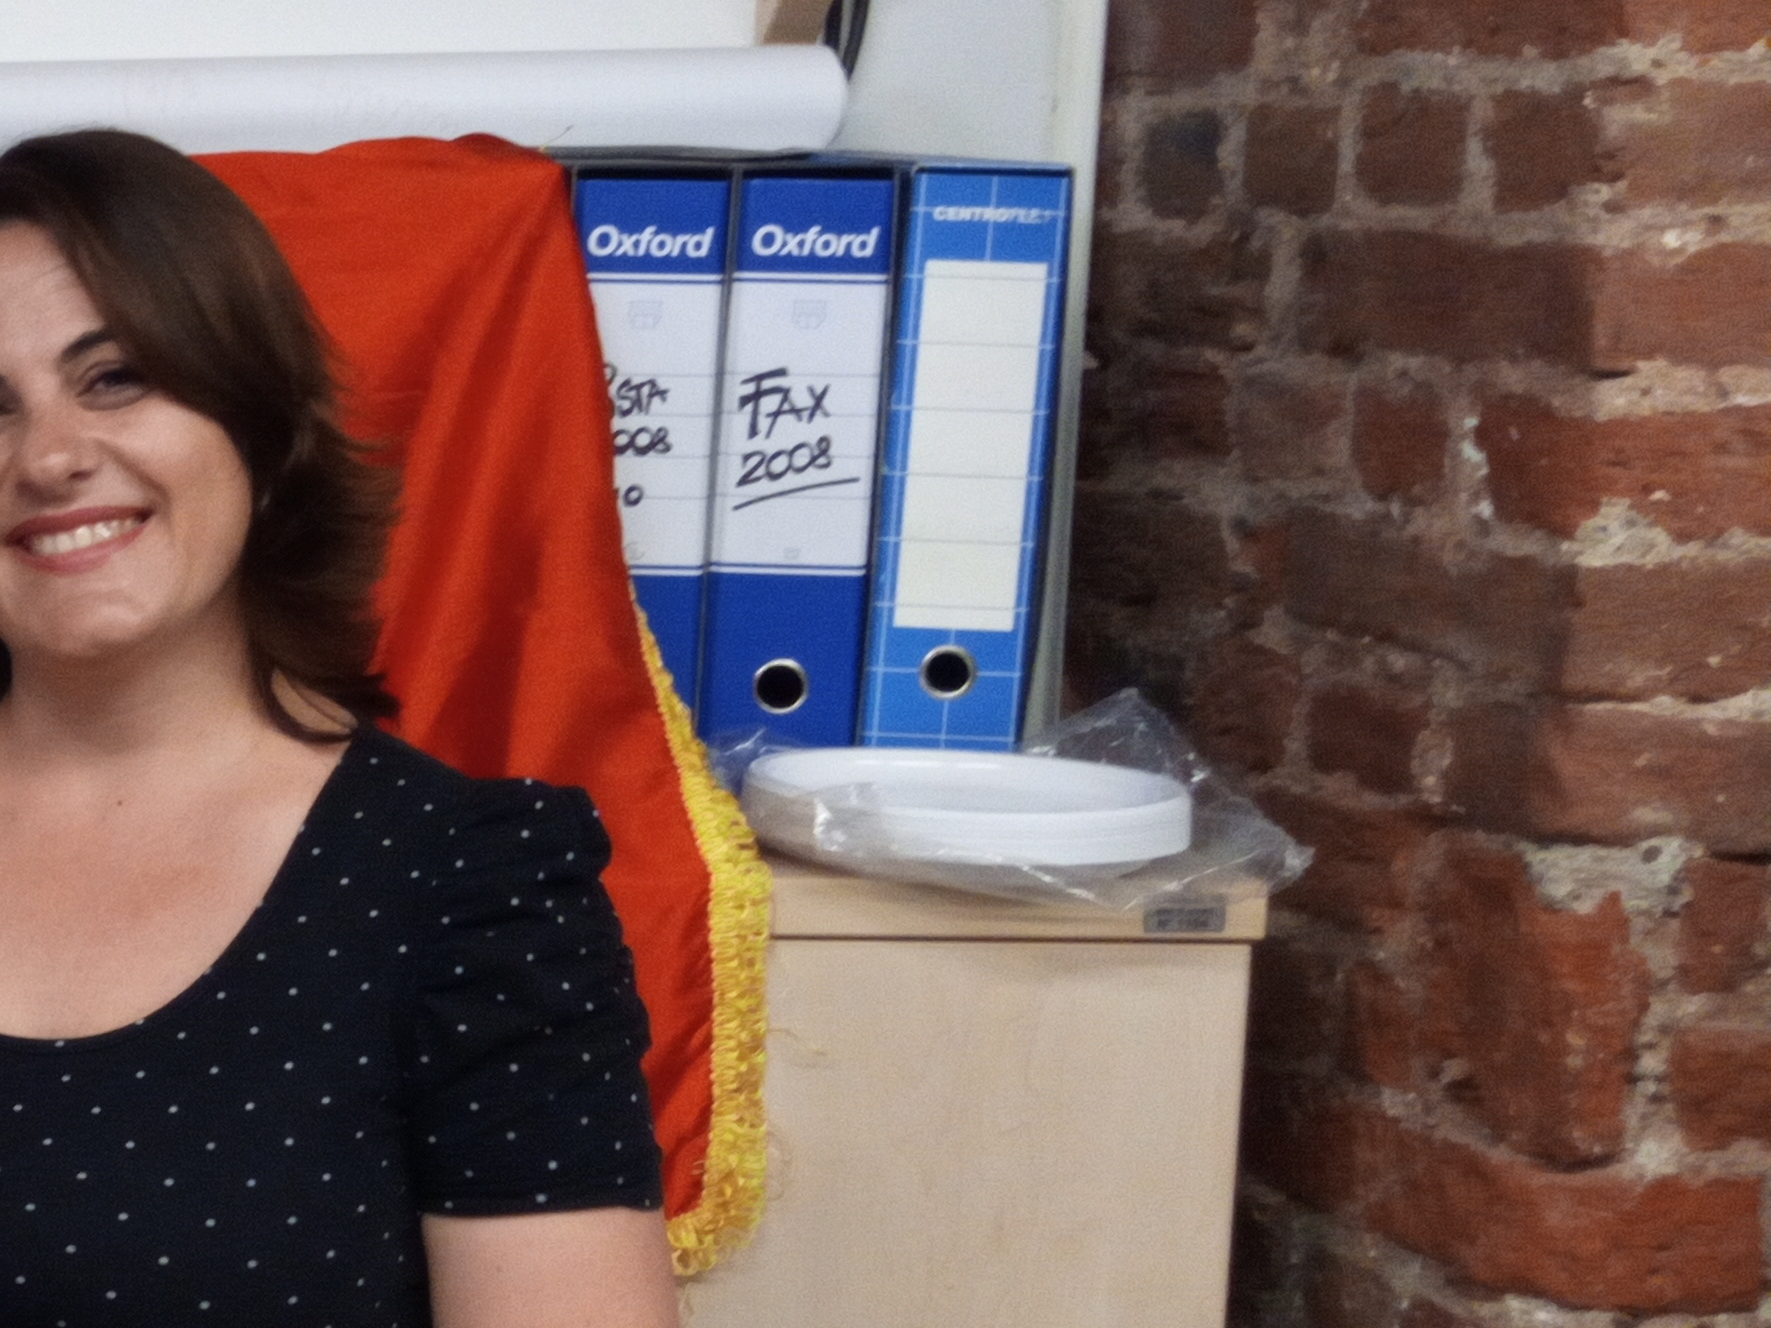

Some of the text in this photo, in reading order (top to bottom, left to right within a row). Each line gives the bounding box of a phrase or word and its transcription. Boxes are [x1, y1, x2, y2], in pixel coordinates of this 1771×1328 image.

[587, 224, 715, 258] Oxford
[751, 224, 881, 258] Oxford
[738, 367, 831, 440] FAX
[611, 426, 672, 456] 008
[735, 435, 833, 488] 2008
